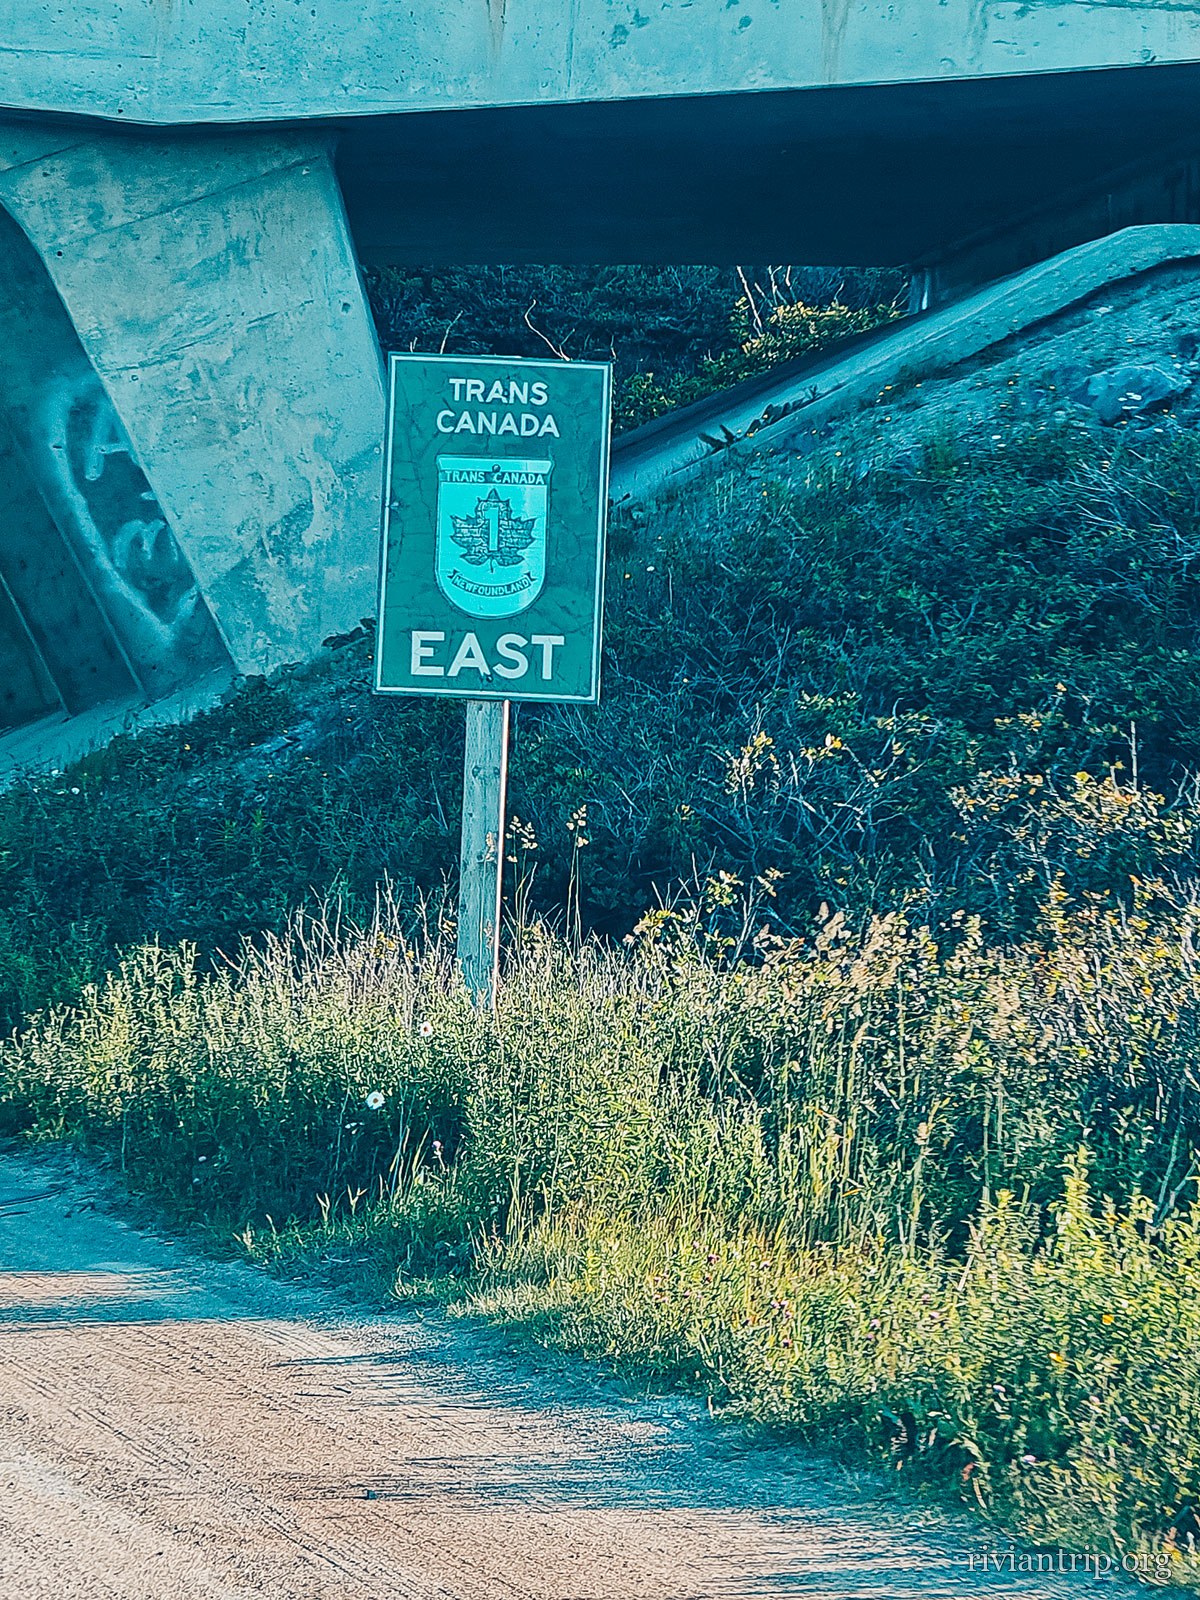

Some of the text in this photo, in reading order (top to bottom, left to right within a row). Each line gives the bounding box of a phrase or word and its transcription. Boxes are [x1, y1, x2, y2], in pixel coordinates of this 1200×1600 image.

[449, 378, 549, 406] TRANS
[436, 409, 560, 438] CANADA
[445, 470, 545, 485] TRANS CANADA
[484, 506, 499, 551] 1
[453, 576, 531, 596] NEWFOUNDLAND
[410, 630, 565, 680] EAST
